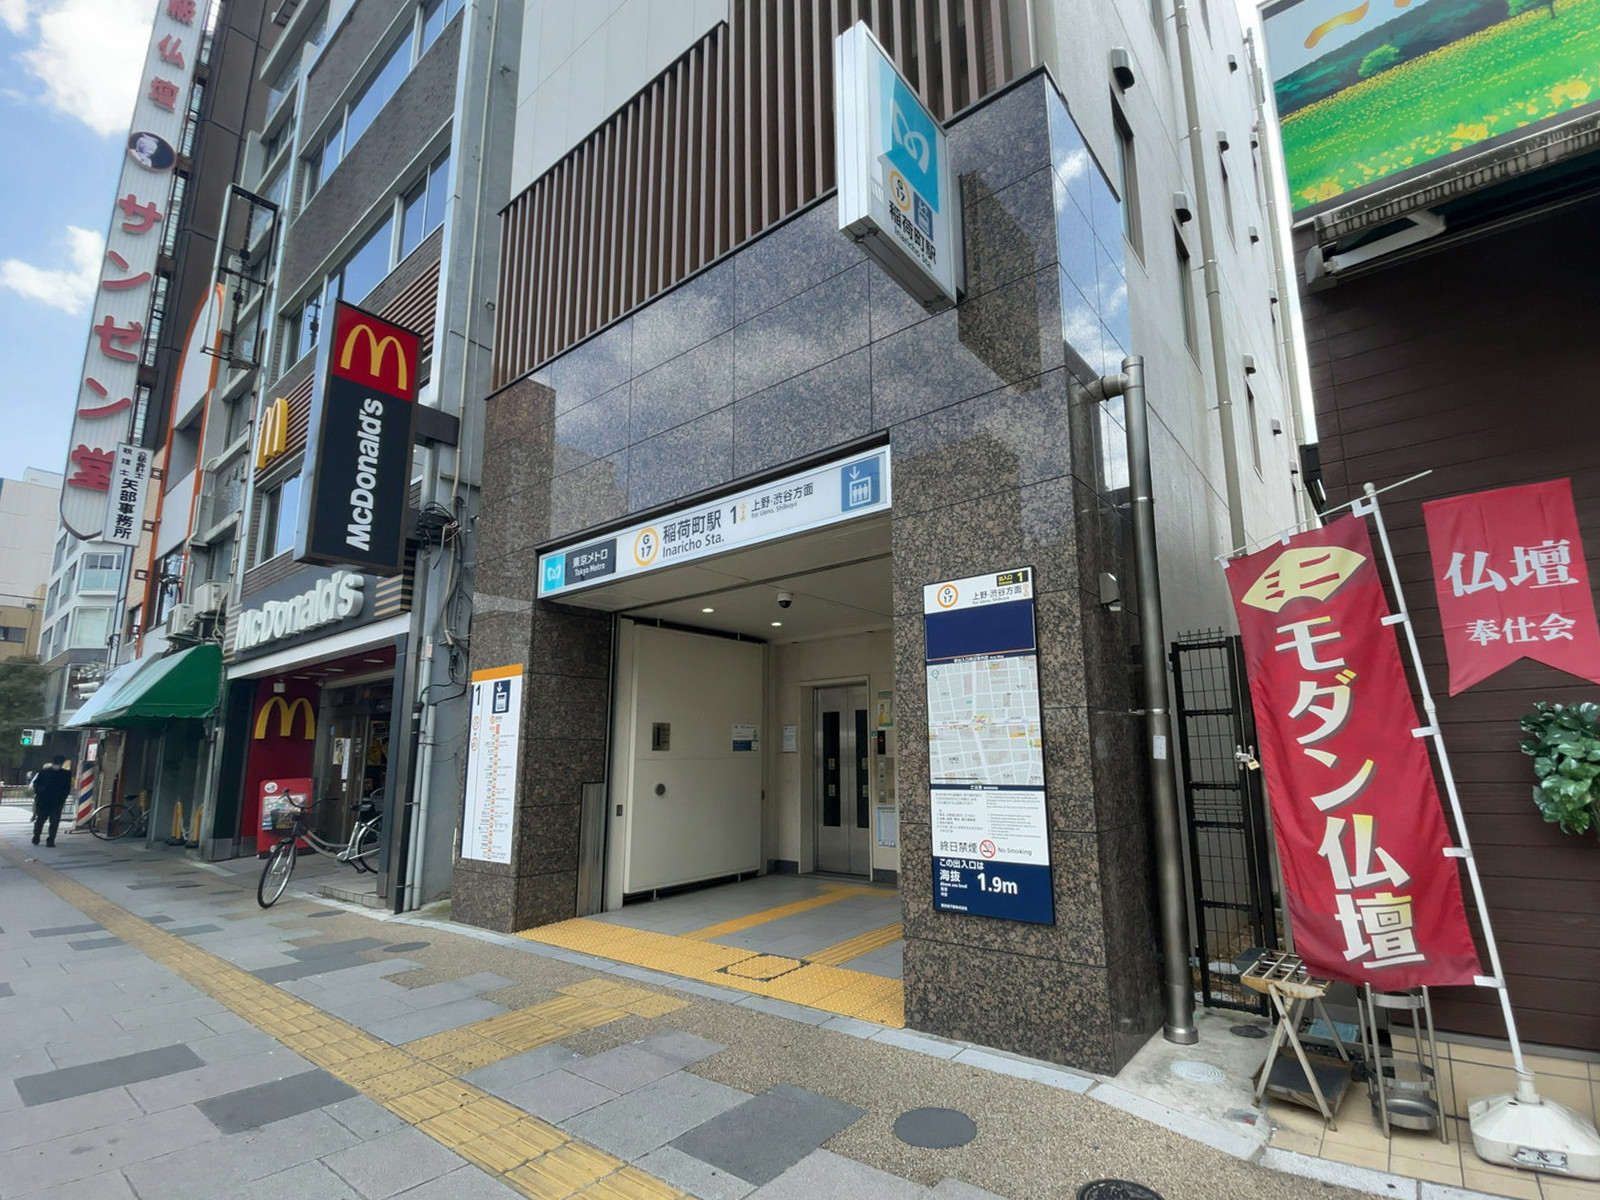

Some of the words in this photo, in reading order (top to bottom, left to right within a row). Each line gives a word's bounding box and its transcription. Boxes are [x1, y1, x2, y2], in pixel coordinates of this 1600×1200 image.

[68, 193, 163, 491] サンゼン堂
[345, 398, 384, 551] McDonald's
[113, 478, 139, 539] 矢部事務所
[730, 505, 738, 524] 1
[662, 509, 722, 545] 稲荷町駅
[642, 534, 650, 545] G
[662, 539, 702, 558] Inaricho
[705, 532, 725, 546] Sta.
[572, 549, 608, 568] 東京メトロ
[640, 545, 652, 558] 17
[574, 567, 590, 577] Tokyo
[590, 563, 606, 573] Metro
[1017, 572, 1023, 582] 1
[1443, 539, 1579, 597] 仏壇
[943, 595, 953, 603] 17
[234, 570, 364, 652] McDonald's
[1464, 612, 1576, 646] 奉仕会
[475, 684, 481, 706] 1
[1275, 615, 1426, 969] モダン仏壇
[940, 841, 978, 854] 終日禁煙
[1007, 847, 1032, 856] Smoking
[939, 858, 985, 870] この出入口は
[939, 869, 961, 882] 海抜
[977, 872, 1018, 895] 1.9m
